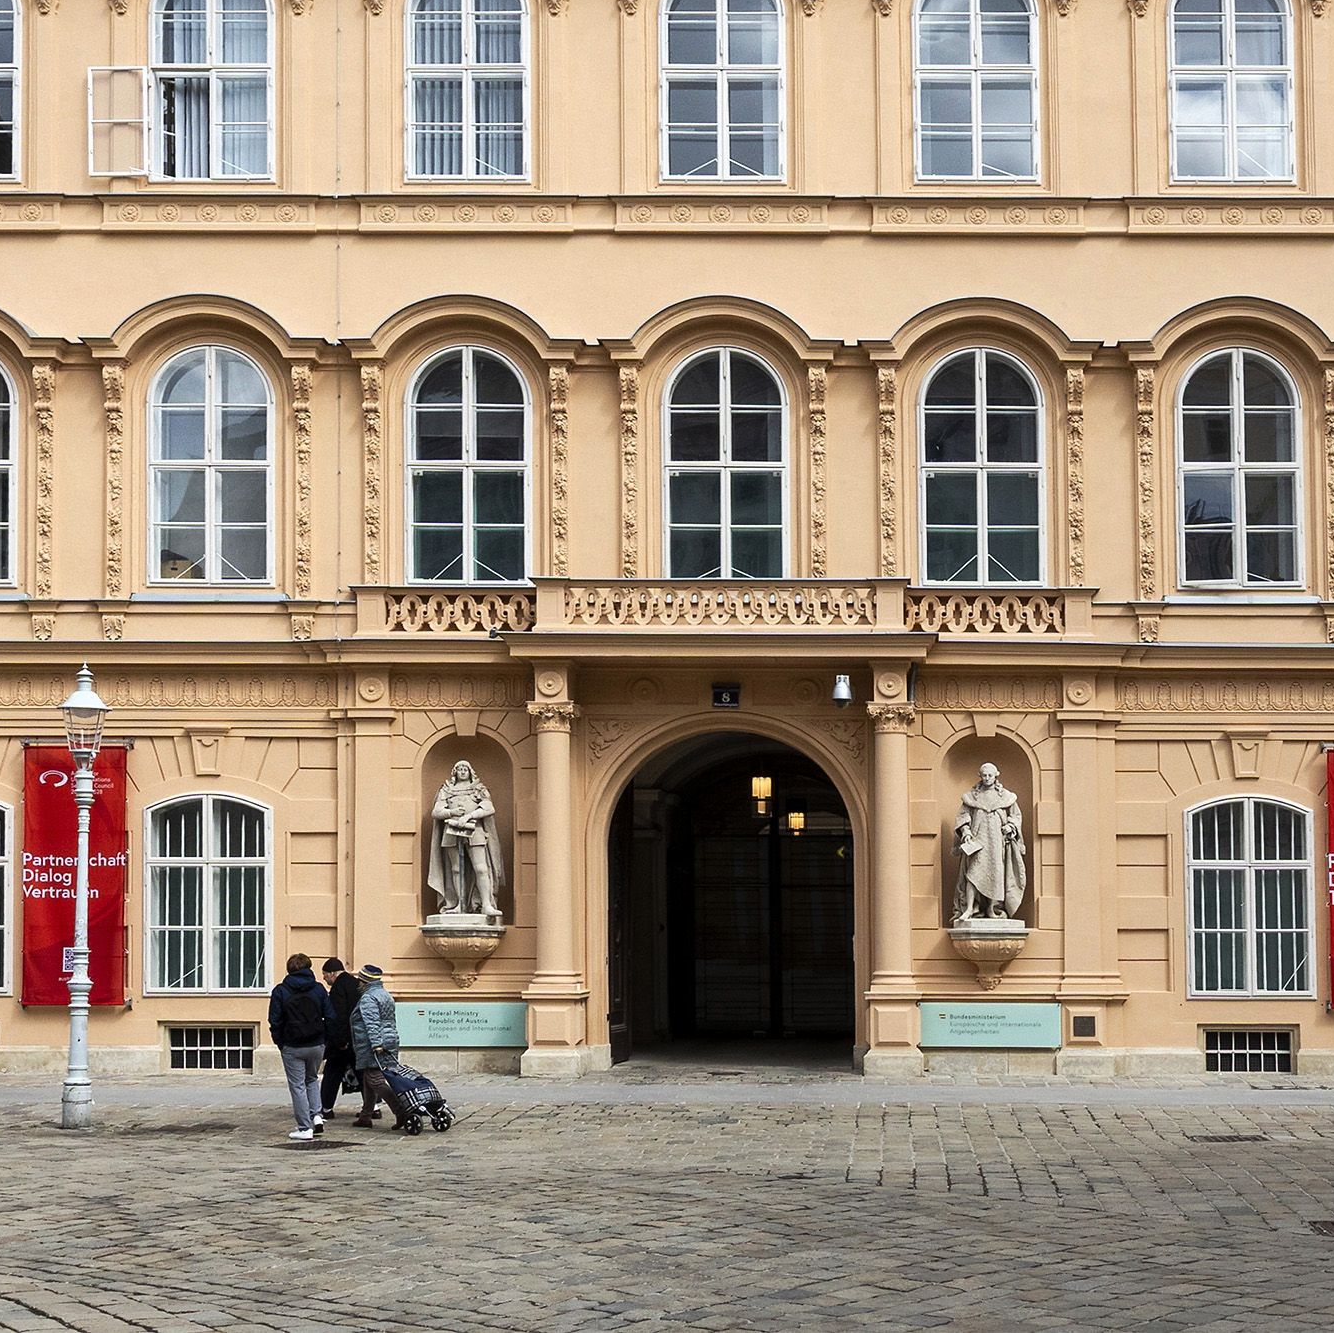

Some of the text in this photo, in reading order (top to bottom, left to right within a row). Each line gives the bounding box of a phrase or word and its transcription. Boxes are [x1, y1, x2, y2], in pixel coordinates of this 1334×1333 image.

[722, 692, 730, 703] 8
[22, 852, 126, 866] Partnerchaft
[22, 868, 72, 886] Dialog
[22, 884, 99, 898] Vertraun
